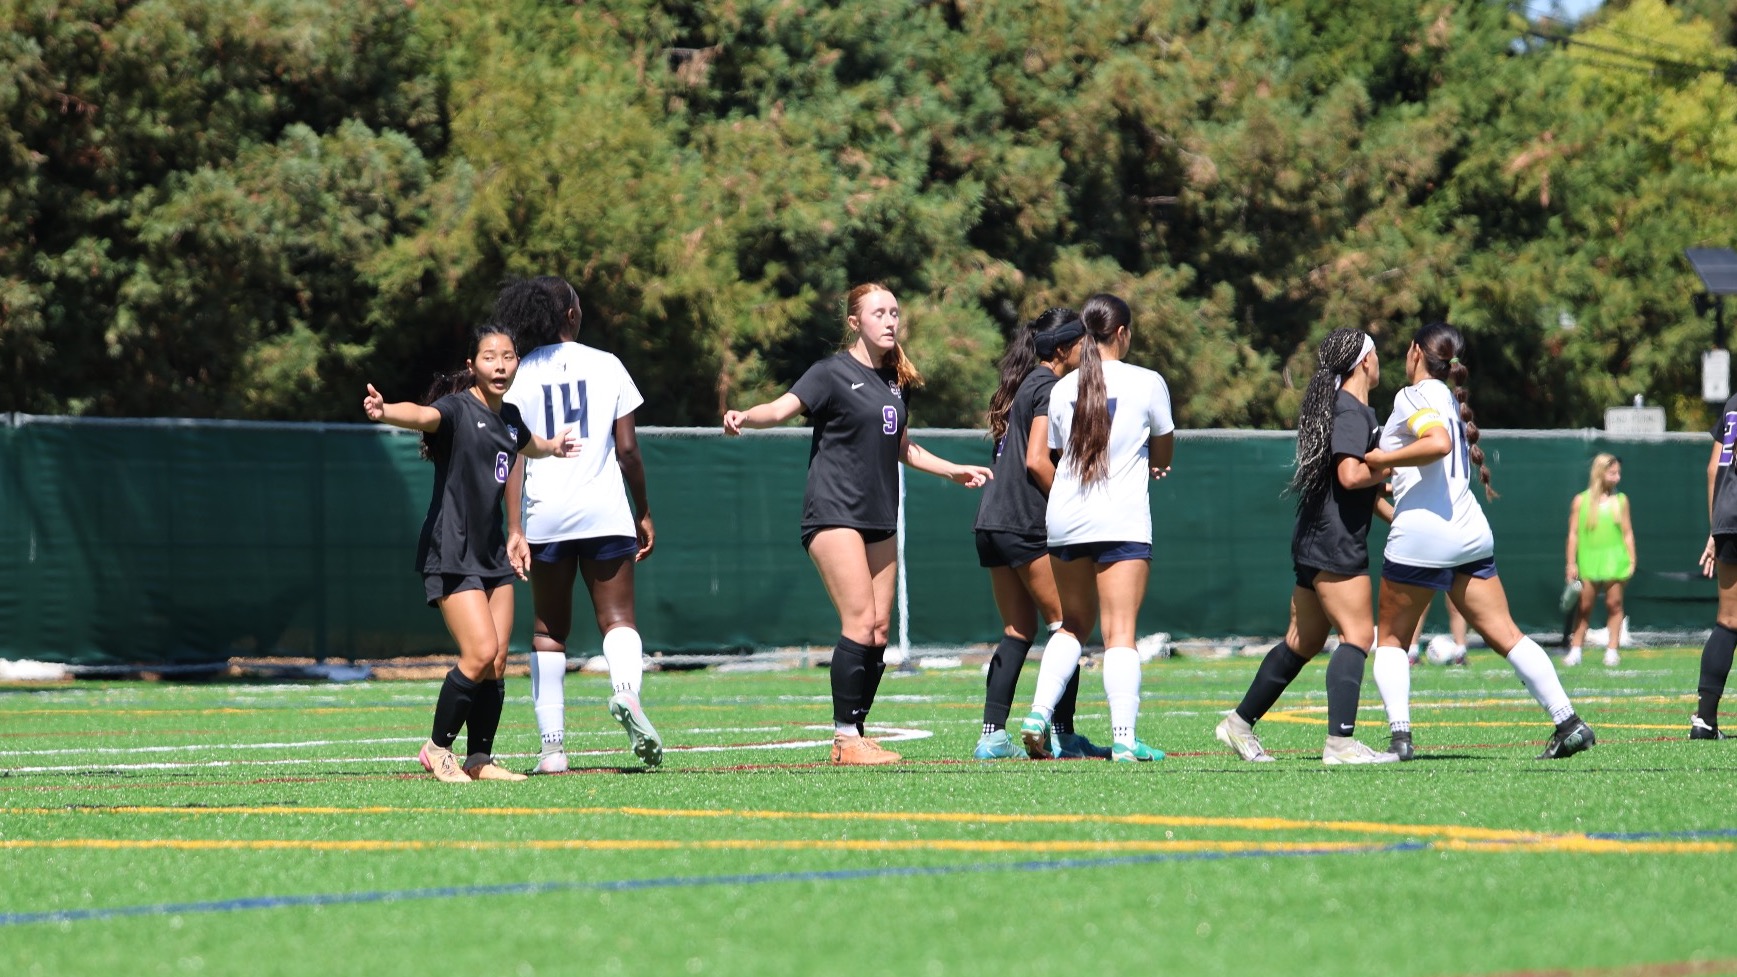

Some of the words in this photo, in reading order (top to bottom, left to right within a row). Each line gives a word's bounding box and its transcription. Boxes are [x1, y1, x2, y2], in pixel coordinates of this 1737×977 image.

[541, 379, 589, 440] 14
[882, 405, 898, 435] 9
[494, 451, 509, 483] 6
